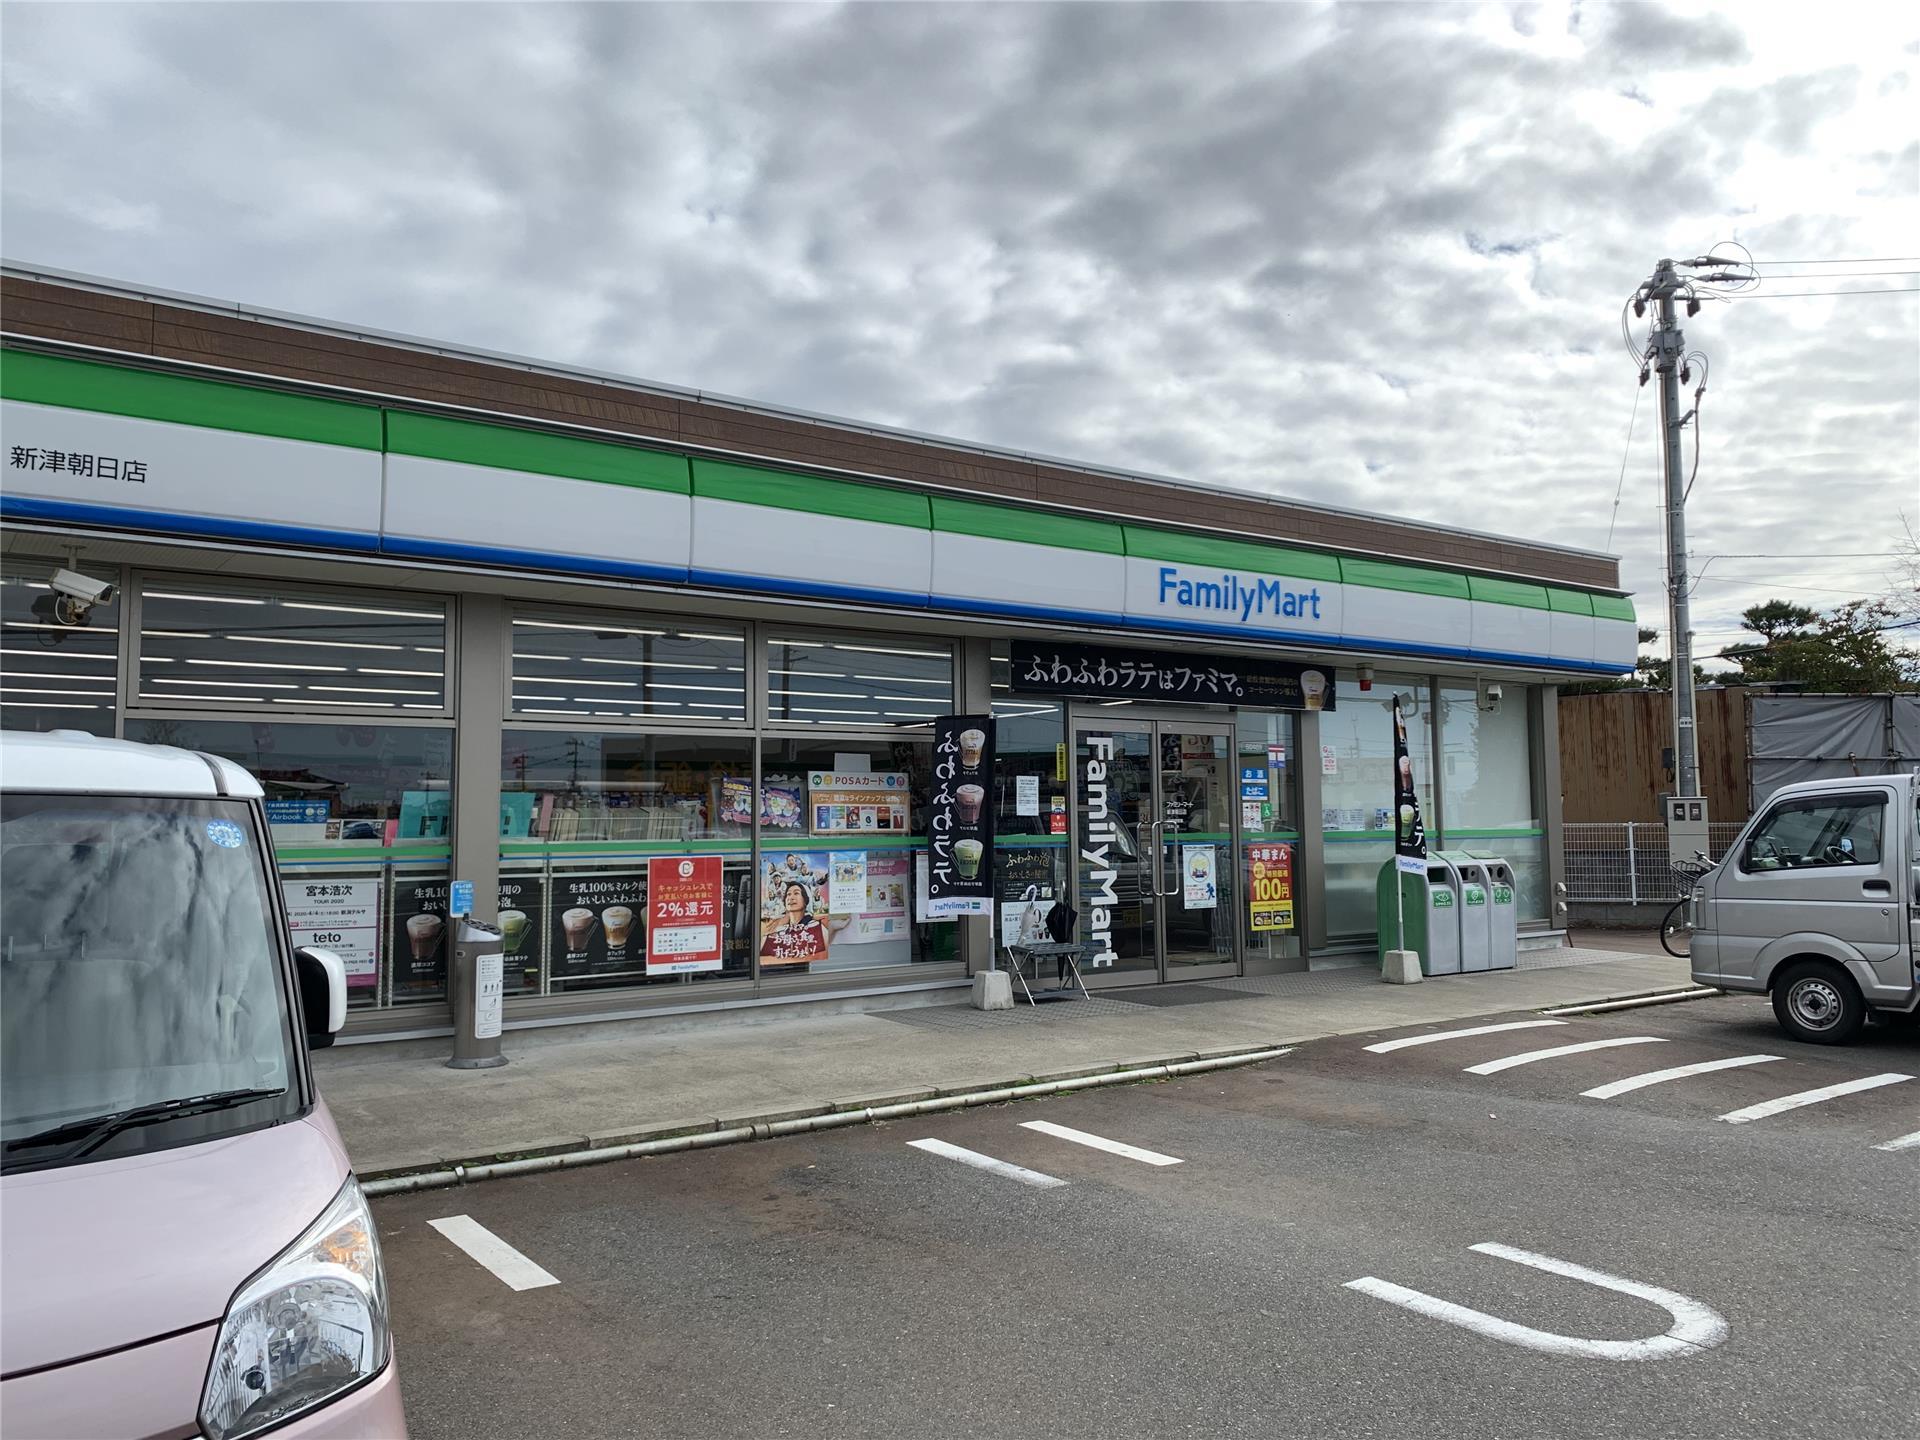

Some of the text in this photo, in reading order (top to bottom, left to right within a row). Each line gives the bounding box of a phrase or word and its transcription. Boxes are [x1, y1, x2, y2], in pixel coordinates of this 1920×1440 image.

[10, 444, 148, 484] 新津朝日店
[1159, 566, 1321, 622] FamilyMart
[1024, 653, 1244, 697] ふわふわラテはファミマ。
[834, 776, 886, 786] POSAカード
[1245, 786, 1265, 796] たばこ
[1081, 736, 1119, 968] FamilyMart
[1252, 848, 1288, 861] 中華まん
[305, 884, 353, 897] 宮本浩次
[658, 883, 713, 893] キャッシュレスで
[657, 901, 714, 918] 2%還元
[312, 931, 342, 943] teto
